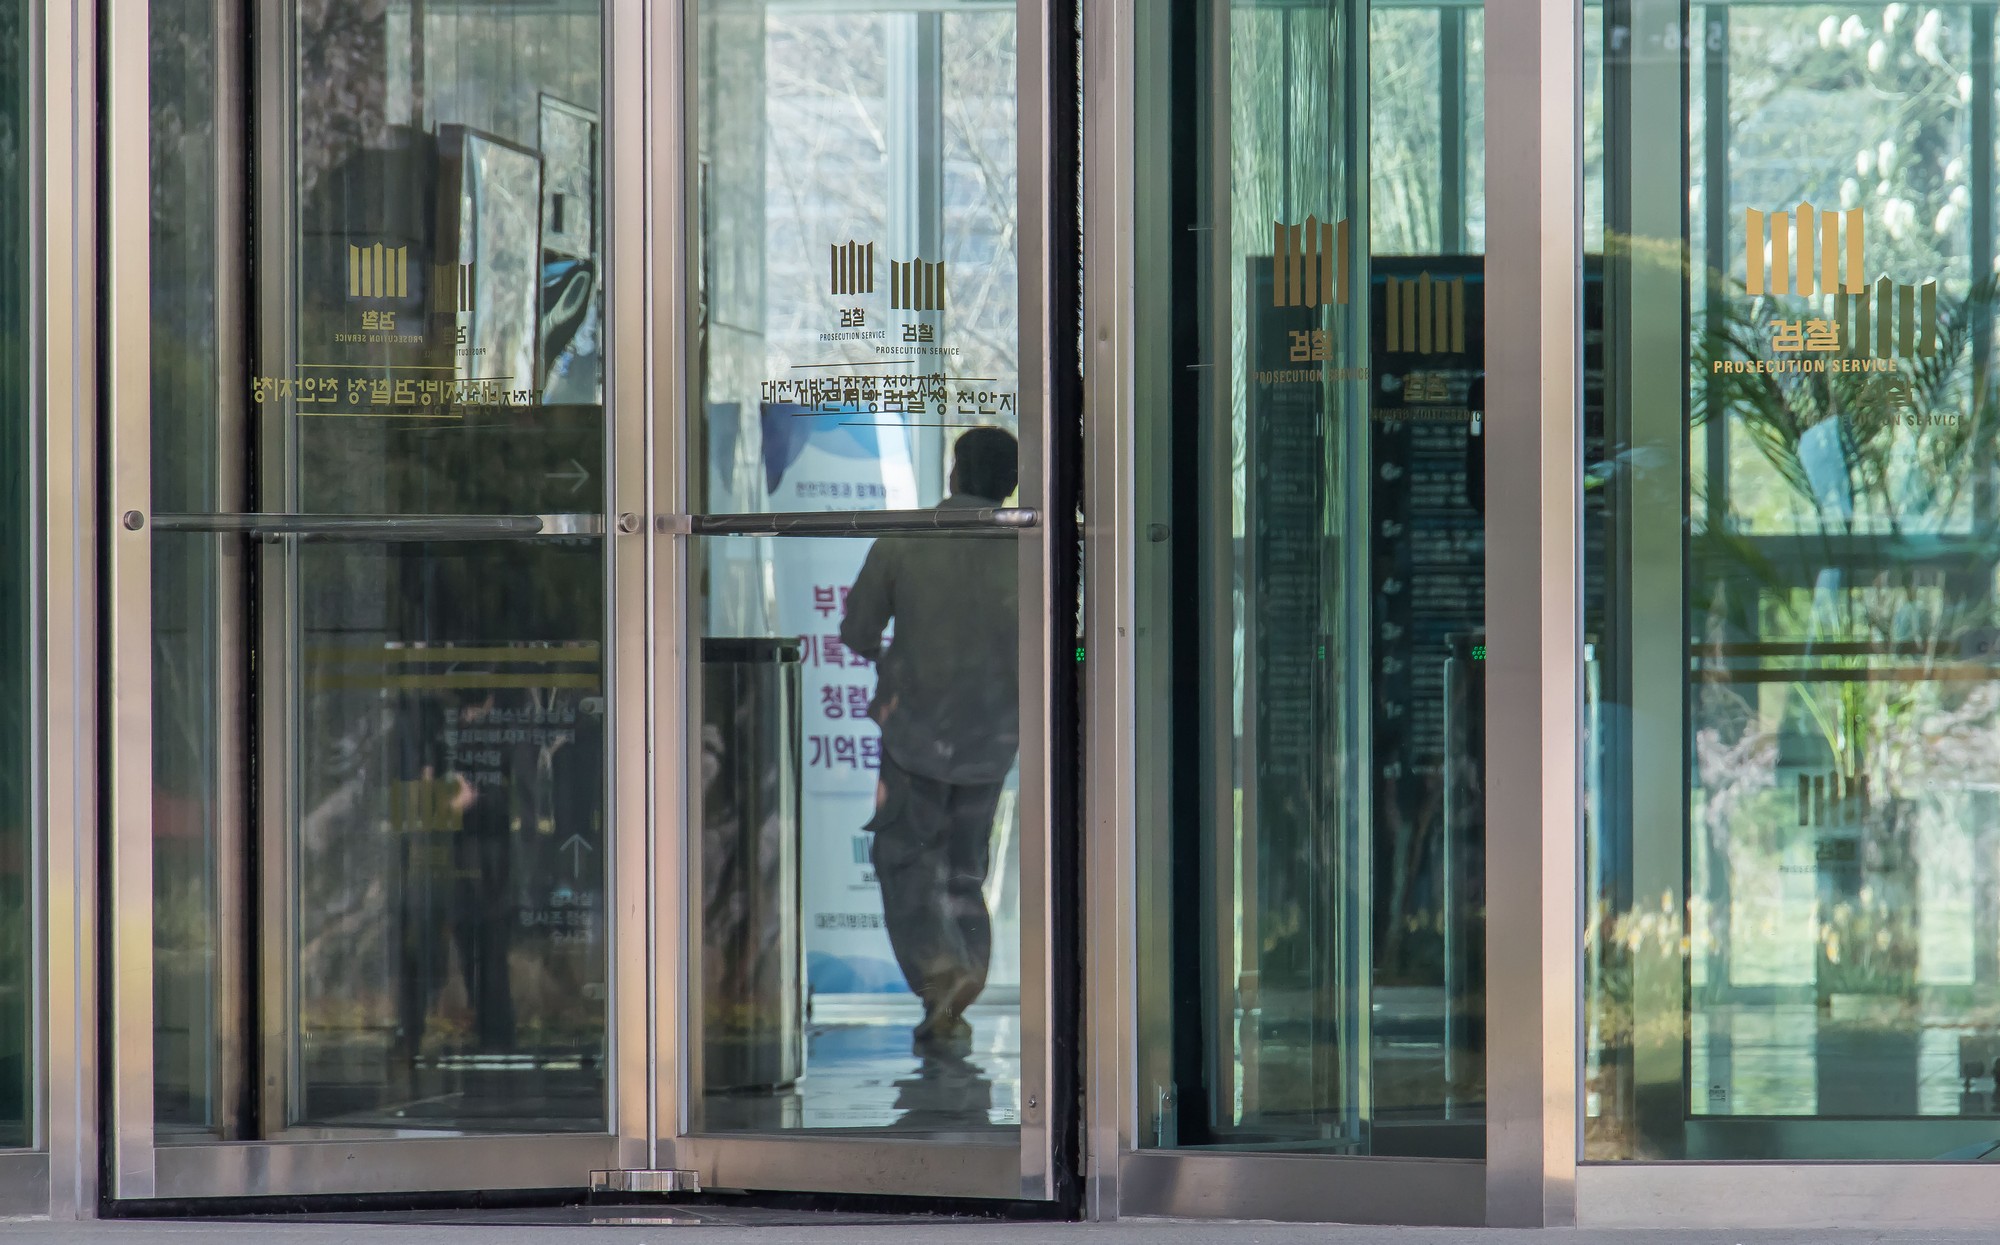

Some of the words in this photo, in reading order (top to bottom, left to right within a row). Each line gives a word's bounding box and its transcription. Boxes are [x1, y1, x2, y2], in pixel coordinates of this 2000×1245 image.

[839, 308, 865, 328] 검찰
[819, 332, 860, 342] PROSECUTION
[861, 330, 886, 340] SERVICE
[902, 323, 934, 343] 검찰
[1770, 318, 1841, 352] 검찰
[875, 346, 927, 356] PROSECUTION
[930, 347, 960, 356] SERVICE
[1288, 328, 1334, 362] 검찰
[1713, 359, 1825, 374] PROSECUTION
[1832, 358, 1897, 373] SERVICE
[1253, 369, 1323, 384] PROSECUTION
[820, 685, 869, 719] 청렴
